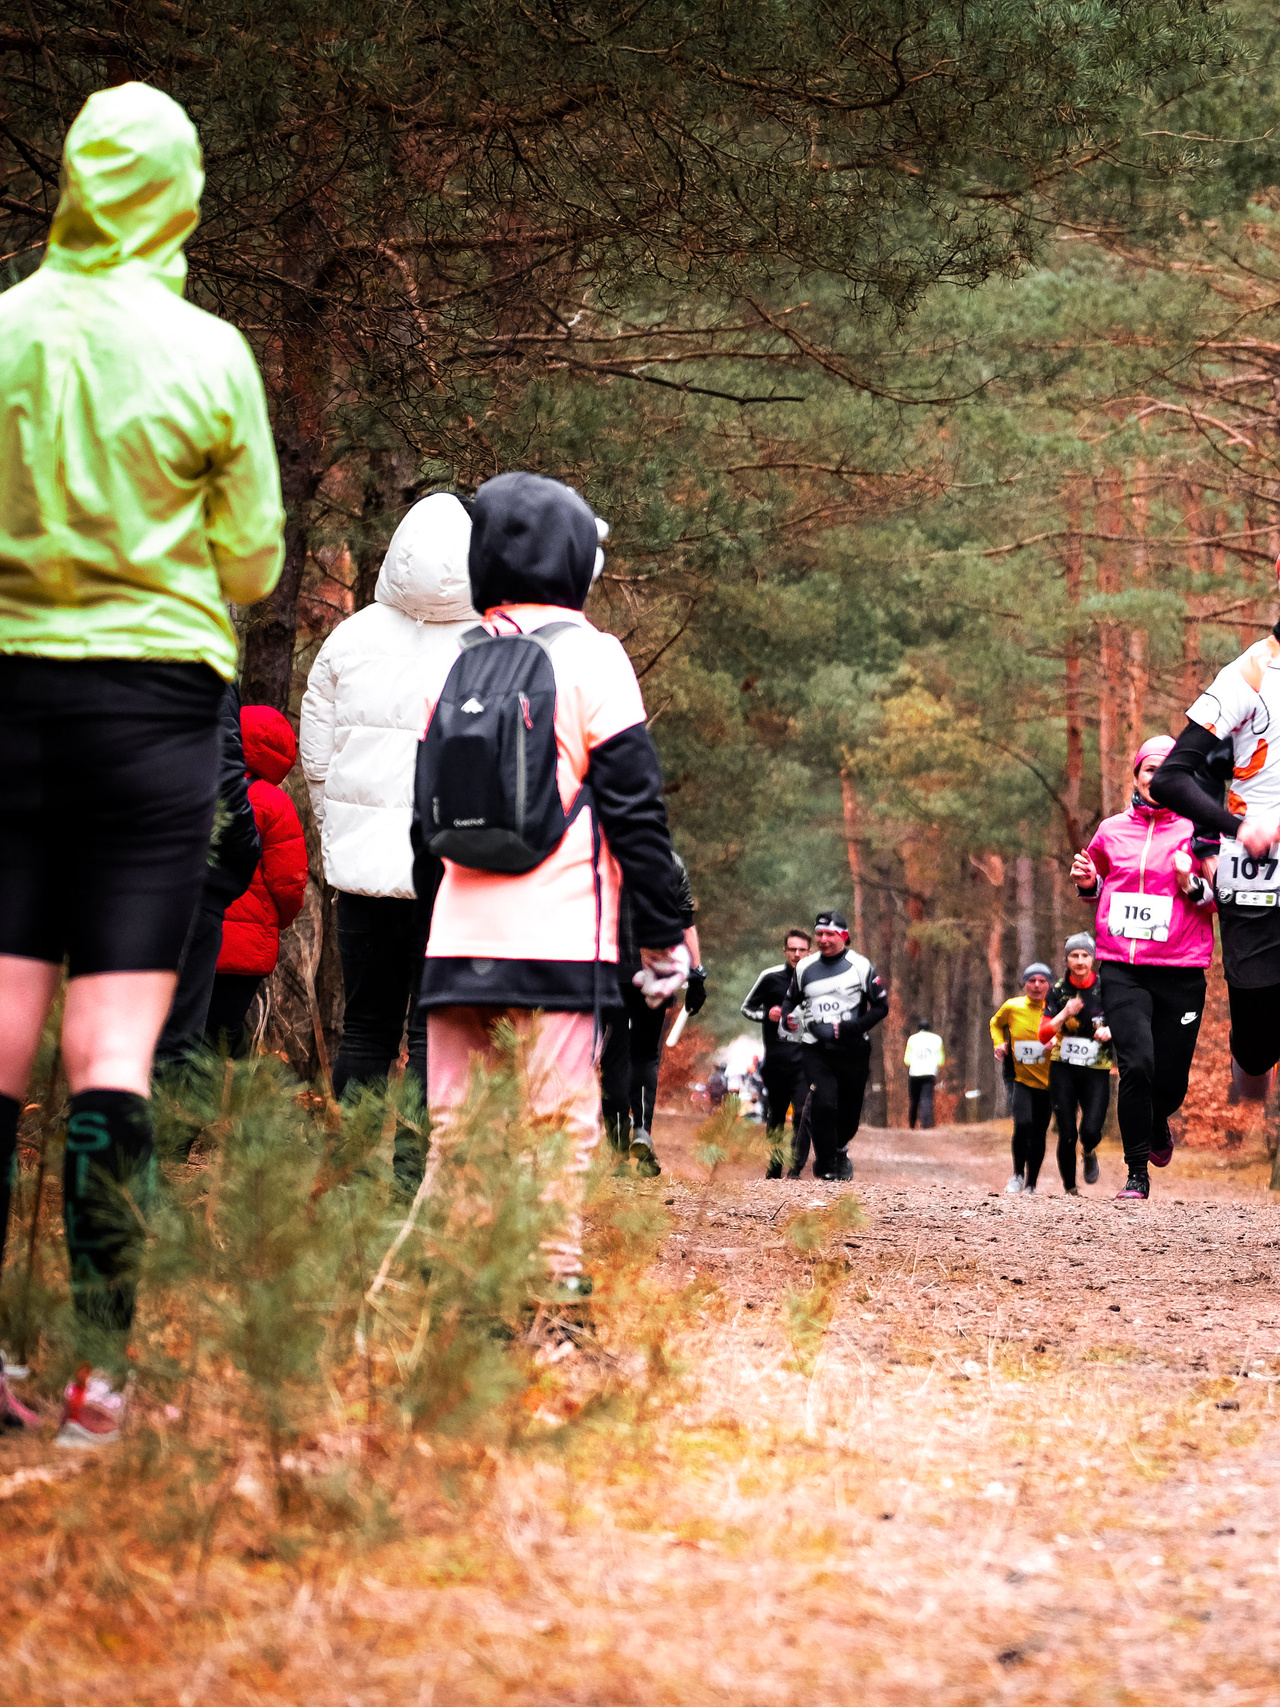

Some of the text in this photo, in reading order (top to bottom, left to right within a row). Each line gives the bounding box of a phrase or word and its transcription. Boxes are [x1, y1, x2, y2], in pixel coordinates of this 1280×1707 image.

[1231, 856, 1279, 881] 107
[1124, 905, 1152, 922] 116
[818, 1001, 840, 1013] 100
[1022, 1046, 1034, 1056] 31
[1065, 1043, 1090, 1056] 320
